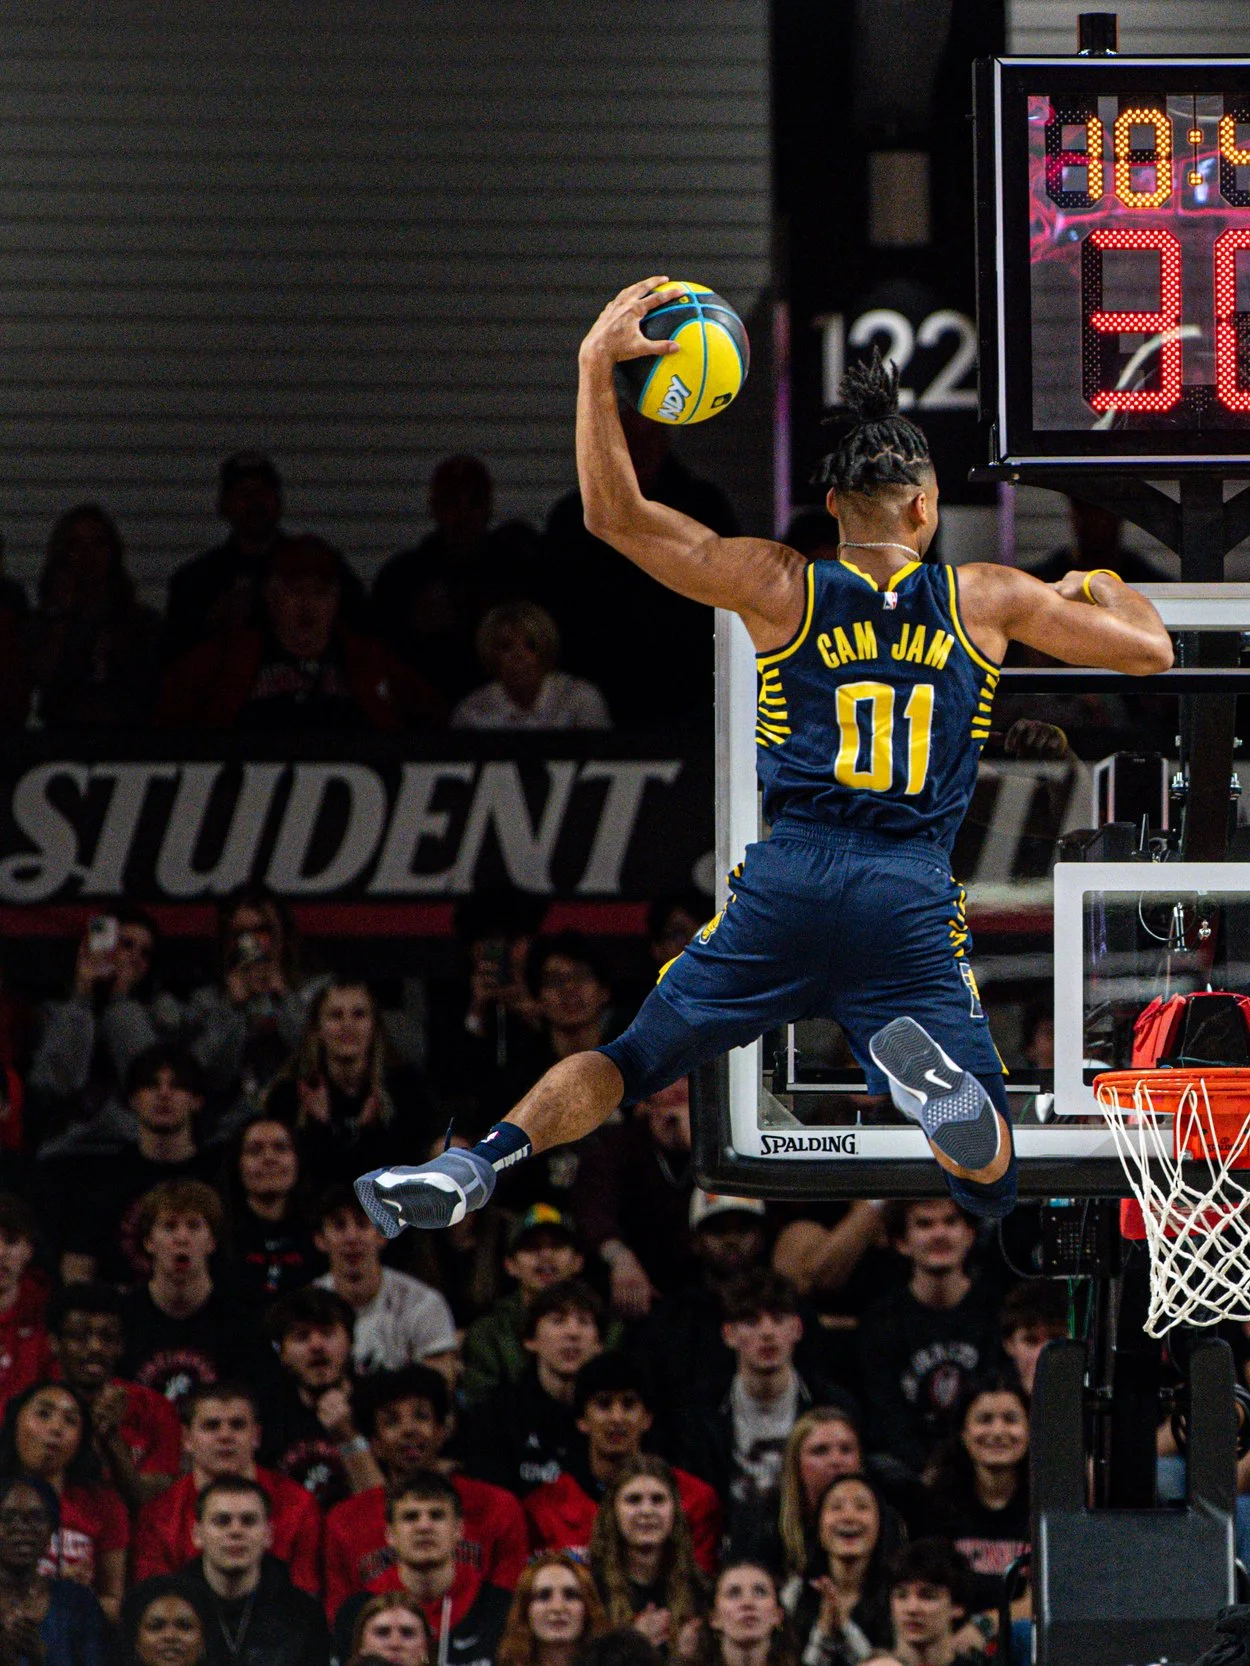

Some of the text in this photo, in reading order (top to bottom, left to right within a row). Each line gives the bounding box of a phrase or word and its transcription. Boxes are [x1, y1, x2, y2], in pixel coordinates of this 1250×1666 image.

[813, 308, 978, 412] 122
[816, 620, 955, 670] CAM JAM
[834, 681, 935, 795] 01
[0, 760, 683, 901] STUDENT
[760, 1133, 857, 1155] SPALDING
